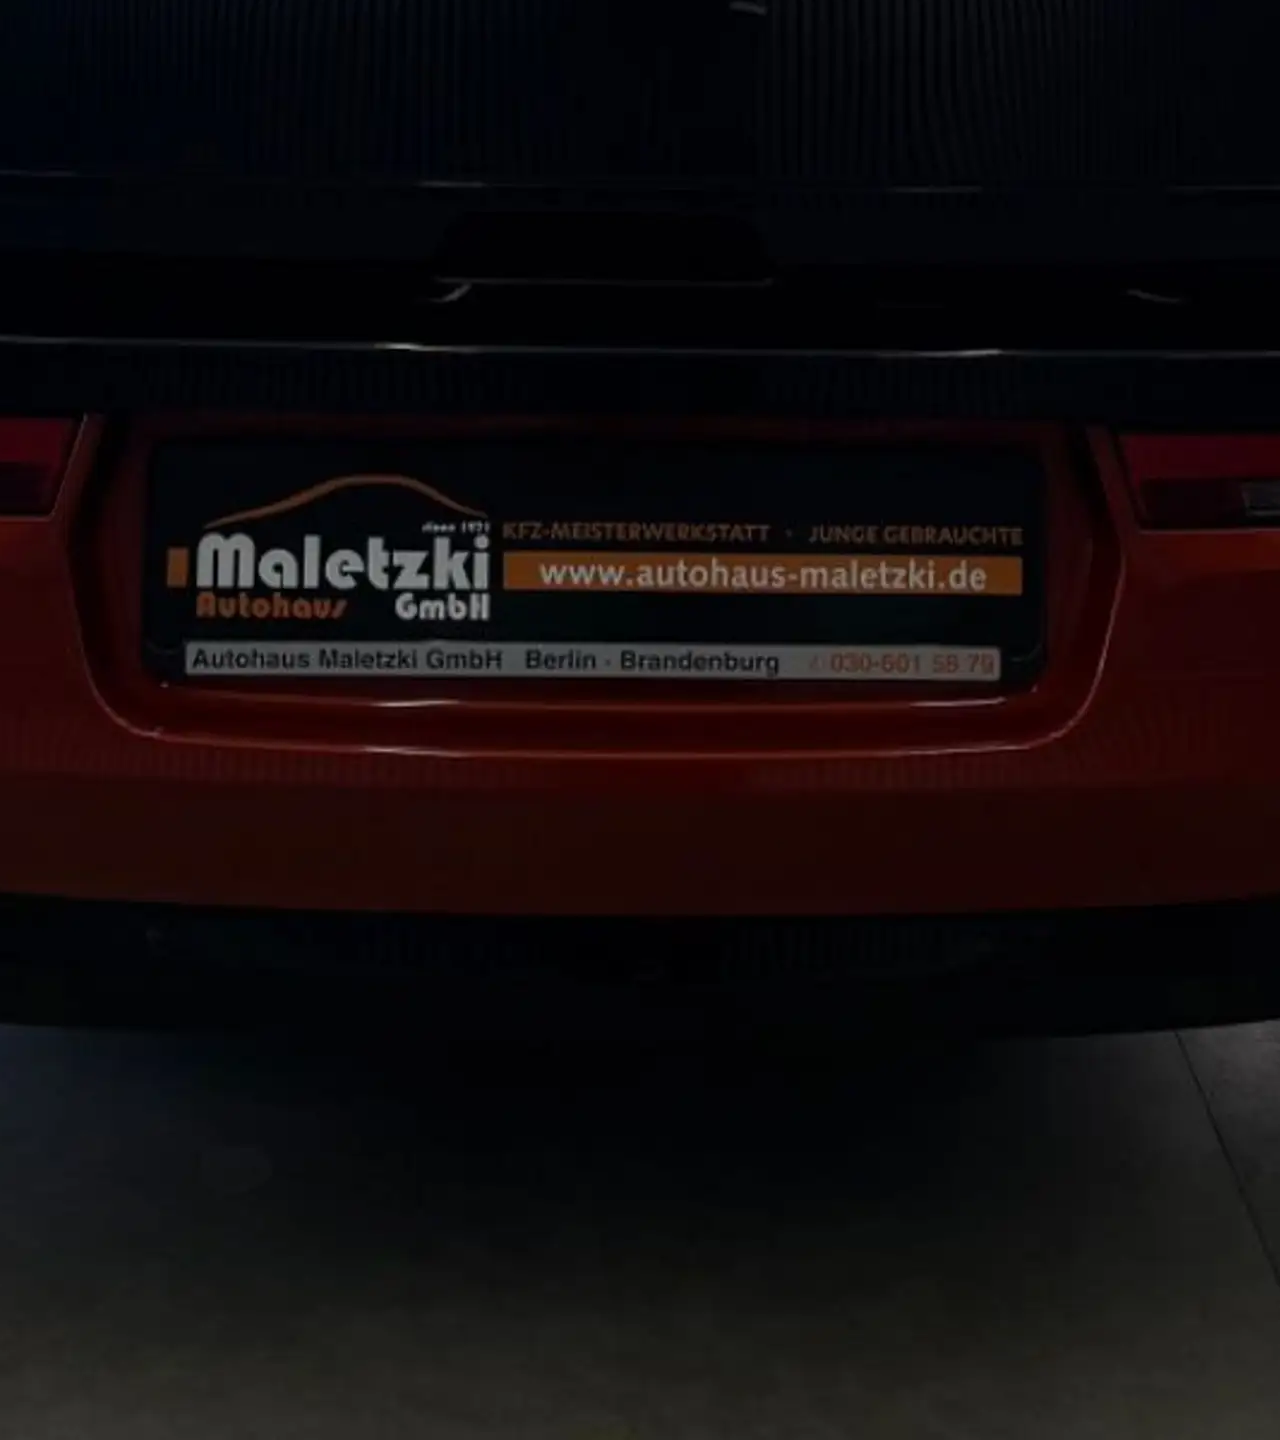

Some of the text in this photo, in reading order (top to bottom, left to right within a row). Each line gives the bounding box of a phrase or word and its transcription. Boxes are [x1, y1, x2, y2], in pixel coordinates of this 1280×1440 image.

[503, 523, 1025, 546] KFZ-MEISTERWERKSTATT JUNGE GEBRAUCHTE
[196, 532, 490, 590] Maletzki
[538, 557, 988, 591] www.autohaus-maletzki.de
[195, 592, 490, 621] Autohaus GmbH
[191, 648, 311, 671] Autohaus
[319, 648, 418, 671] Maletzki
[425, 648, 503, 671] GmbH
[524, 648, 597, 672] Berlin
[621, 649, 779, 678] Brandenburg
